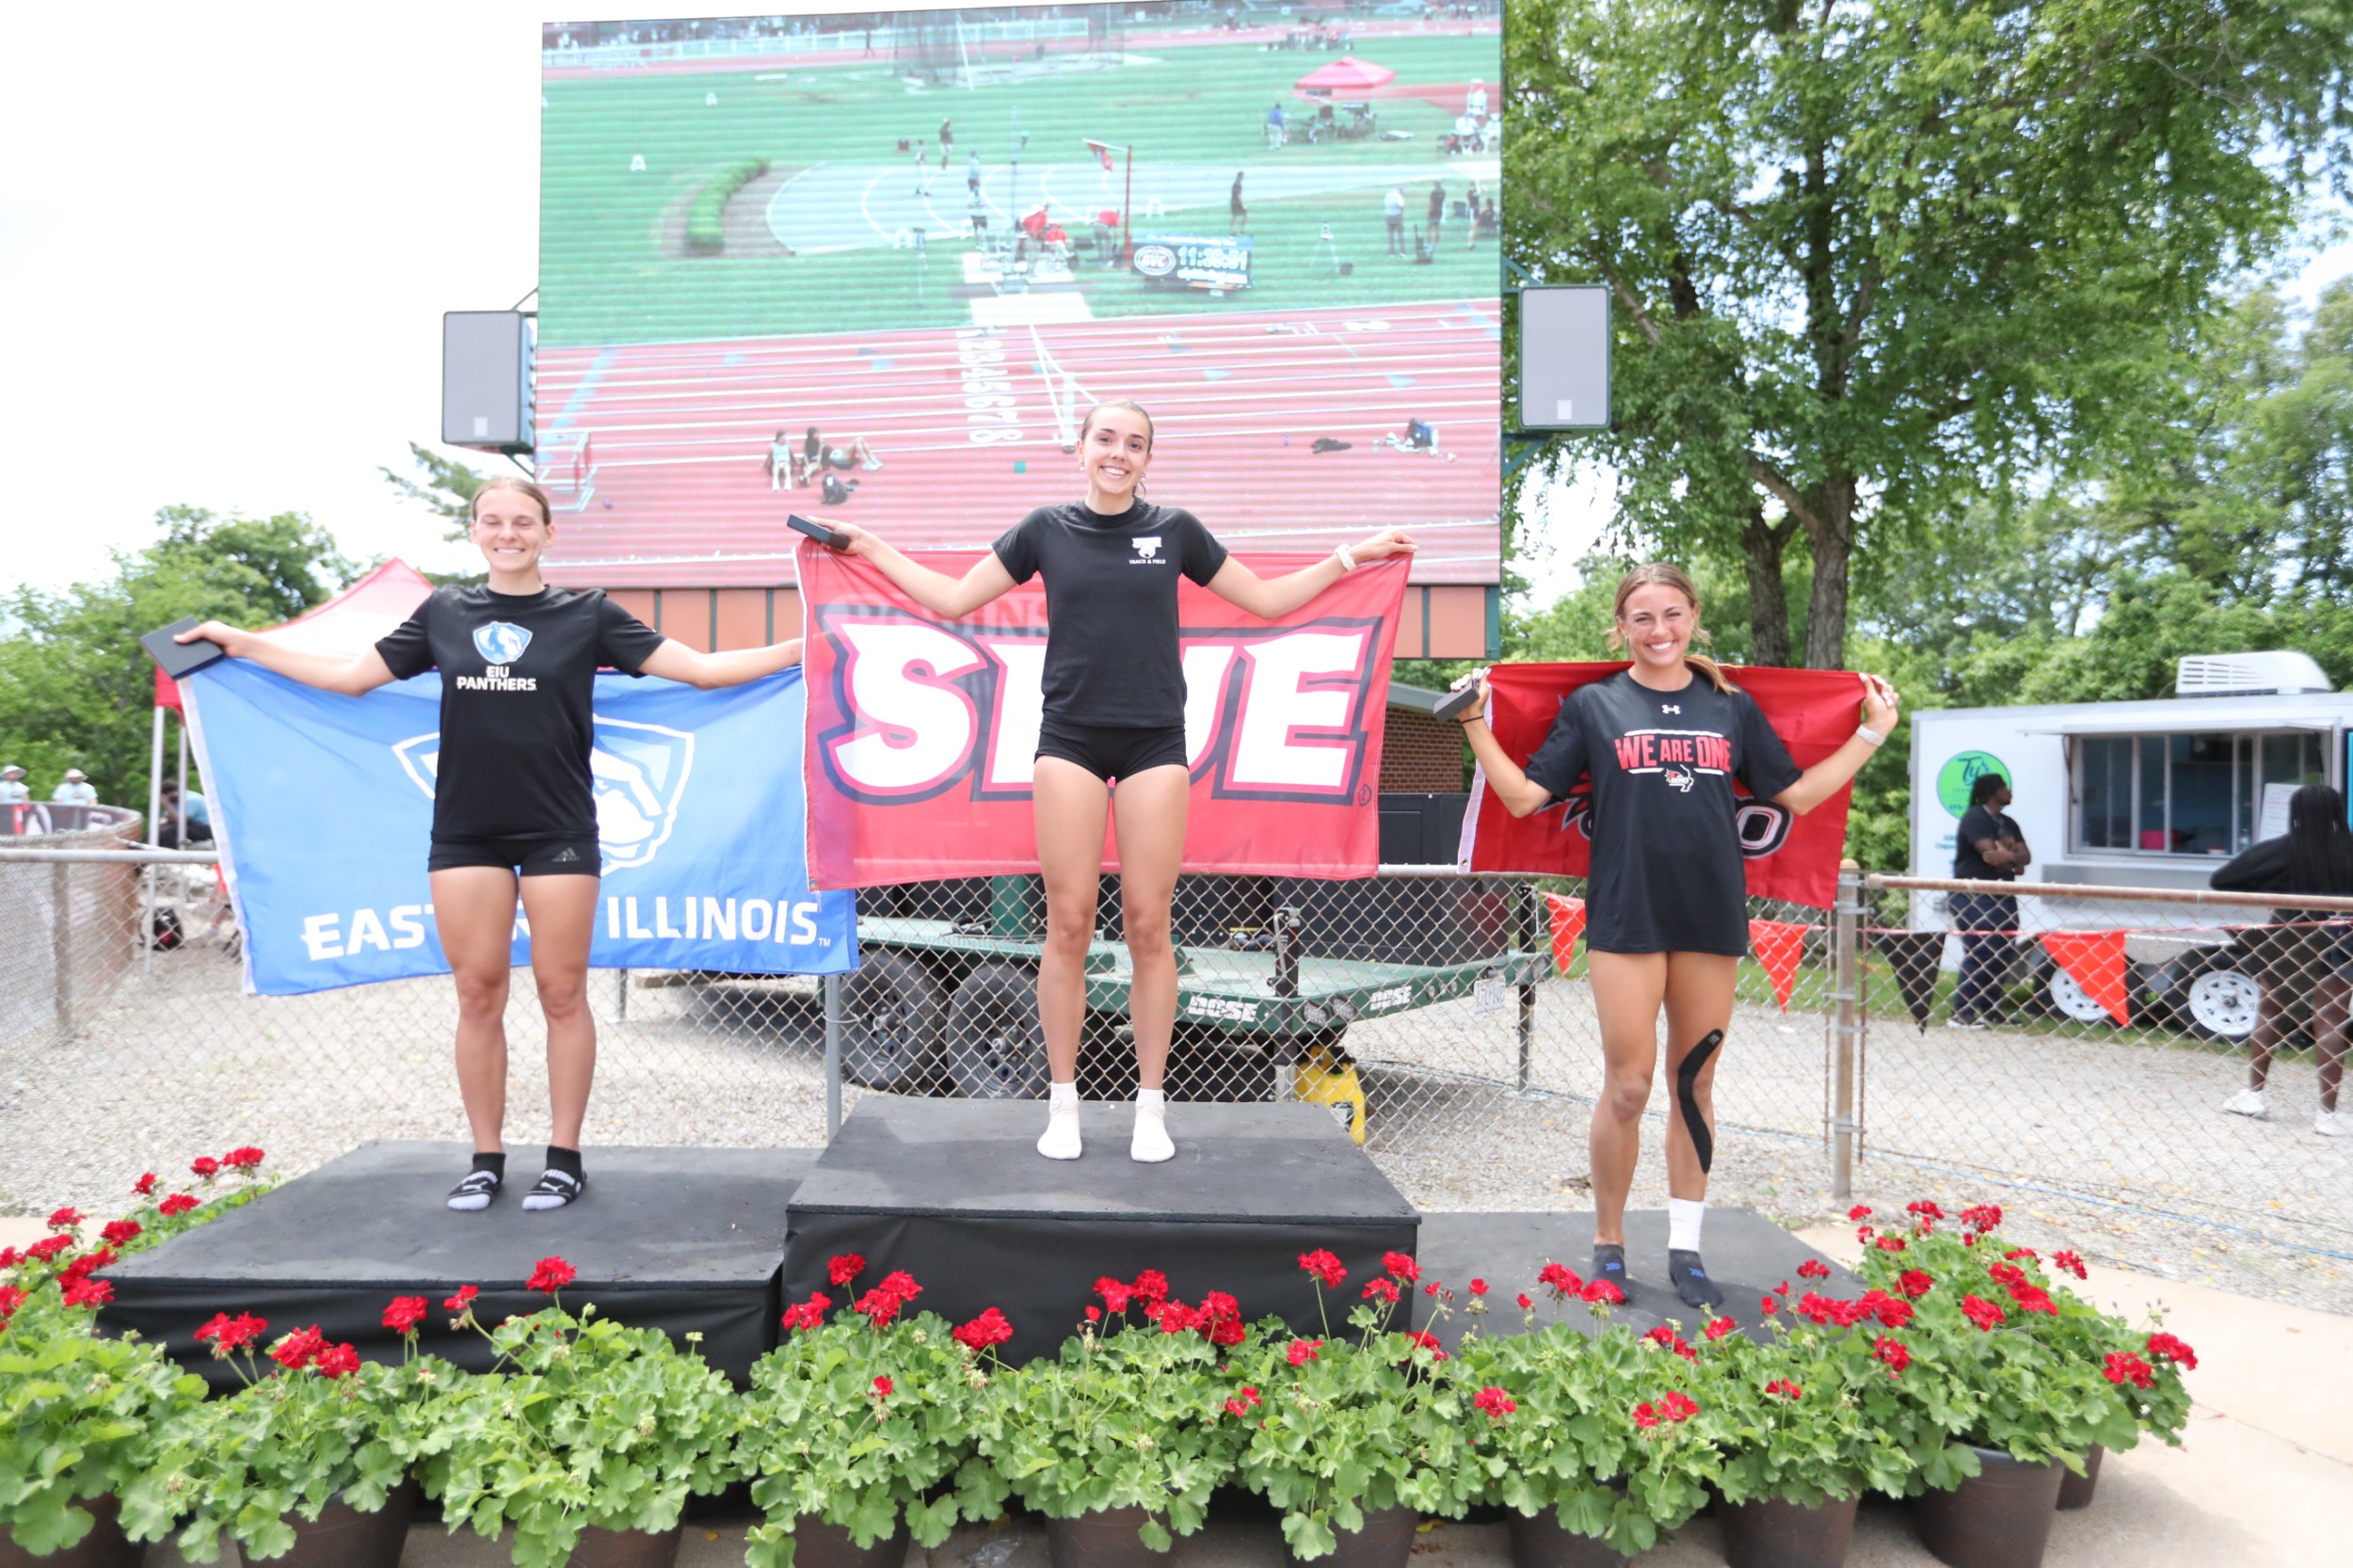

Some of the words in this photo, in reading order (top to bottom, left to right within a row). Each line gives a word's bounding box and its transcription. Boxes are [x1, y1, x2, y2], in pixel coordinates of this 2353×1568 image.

[456, 676, 536, 691] PANTHERS
[486, 665, 509, 679] EIU
[1615, 734, 1657, 770] WE
[1659, 739, 1694, 762] ARE
[1695, 736, 1732, 773] ONE
[607, 896, 819, 946] ILLINOIS
